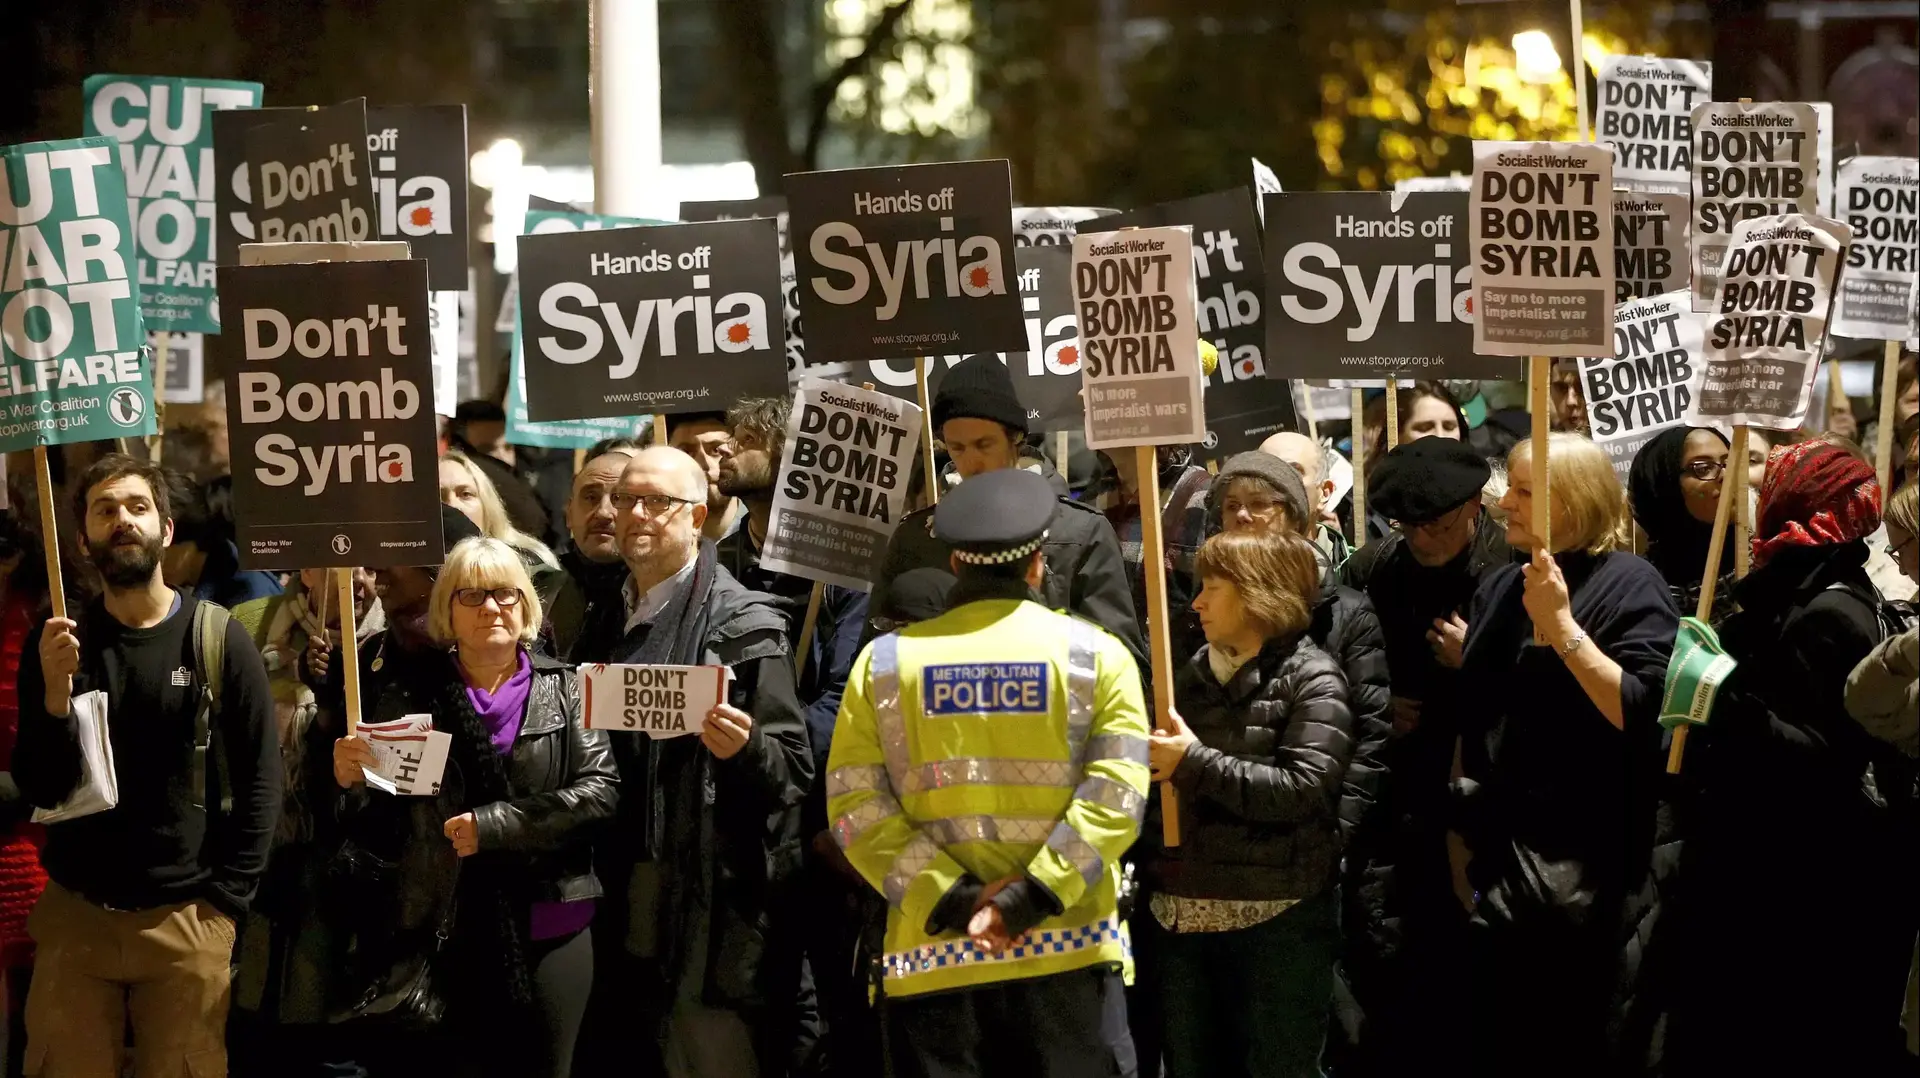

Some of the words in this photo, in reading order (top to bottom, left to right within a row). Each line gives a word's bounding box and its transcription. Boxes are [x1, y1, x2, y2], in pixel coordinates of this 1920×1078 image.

[1616, 66, 1650, 79] Socialist
[1651, 69, 1687, 81] Worker
[1605, 80, 1697, 112] DON'T
[1711, 113, 1755, 127] Socialist
[1755, 114, 1795, 127] Worker
[367, 128, 398, 151] off
[1701, 130, 1806, 163] DON'T
[261, 143, 357, 210] Don't
[1497, 154, 1544, 169] Socialist
[1544, 155, 1588, 169] Worker
[1481, 171, 1600, 206] DON'T
[1701, 166, 1804, 199] BOMB
[1861, 173, 1902, 185] Socialist
[854, 190, 923, 216] Hands
[927, 187, 954, 211] off
[1624, 200, 1663, 212] Worker
[1021, 219, 1063, 230] Socialist
[1335, 215, 1415, 238] Hands
[1420, 215, 1453, 238] off
[1481, 207, 1600, 242] BOMB
[1776, 226, 1814, 242] Worker
[0, 218, 128, 292] AR
[590, 249, 673, 276] Hands
[677, 246, 711, 270] off
[1090, 240, 1130, 257] Socialist
[1129, 239, 1165, 254] Worker
[1479, 243, 1601, 278] SYRIA
[1702, 250, 1720, 263] Say
[1726, 244, 1825, 279] DON'T
[809, 216, 1007, 321] Syria
[1076, 254, 1172, 299] DON'T
[1484, 290, 1508, 305] Say
[1511, 293, 1527, 305] no
[1530, 292, 1544, 305] to
[1548, 294, 1586, 306] more
[1634, 302, 1671, 318] Worker
[1720, 279, 1816, 314] BOMB
[537, 275, 771, 380] Syria
[1079, 294, 1177, 339] BOMB
[1485, 305, 1557, 321] imperialist
[1560, 309, 1587, 320] war
[243, 304, 408, 361] Don't
[872, 330, 960, 344] www.stopwar.org.uk
[1486, 325, 1590, 341] www.swp.org.uk
[1585, 312, 1680, 369] ON'T
[1710, 315, 1806, 351] SYRIA
[1084, 333, 1175, 379] SYRIA
[1340, 355, 1445, 368] www.stopwar.org.uk
[1751, 363, 1786, 376] more
[1586, 348, 1693, 403] BOMB
[1759, 379, 1783, 391] war
[9, 403, 38, 417] War
[40, 396, 100, 413] Coalition
[238, 368, 420, 426] Bomb
[603, 386, 710, 403] www.stopwar.org.uk
[820, 391, 866, 413] Socialist
[866, 401, 900, 423] Worker
[1090, 386, 1104, 402] No
[1106, 386, 1137, 400] more
[1092, 402, 1151, 422] imperialist
[1154, 401, 1187, 416] wars
[1593, 384, 1691, 437] SYRIA
[800, 403, 908, 458] DON'T
[254, 431, 414, 497] Syria
[791, 436, 899, 490] BOMB
[783, 470, 890, 525] SYRIA
[778, 525, 848, 552] imperialist
[850, 543, 873, 558] war
[780, 511, 805, 529] Say
[807, 518, 824, 532] no
[826, 522, 840, 536] to
[842, 528, 875, 545] more
[251, 540, 267, 548] Stop
[267, 540, 278, 548] the
[279, 540, 292, 548] War
[380, 539, 427, 549] stopwar.org.uk
[623, 667, 688, 690] DON'T
[932, 665, 1040, 681] METROPOLITAN
[624, 687, 686, 710] BOMB
[934, 680, 1040, 710] POLICE
[1693, 682, 1712, 719] Muslim
[622, 708, 686, 731] SYRIA
